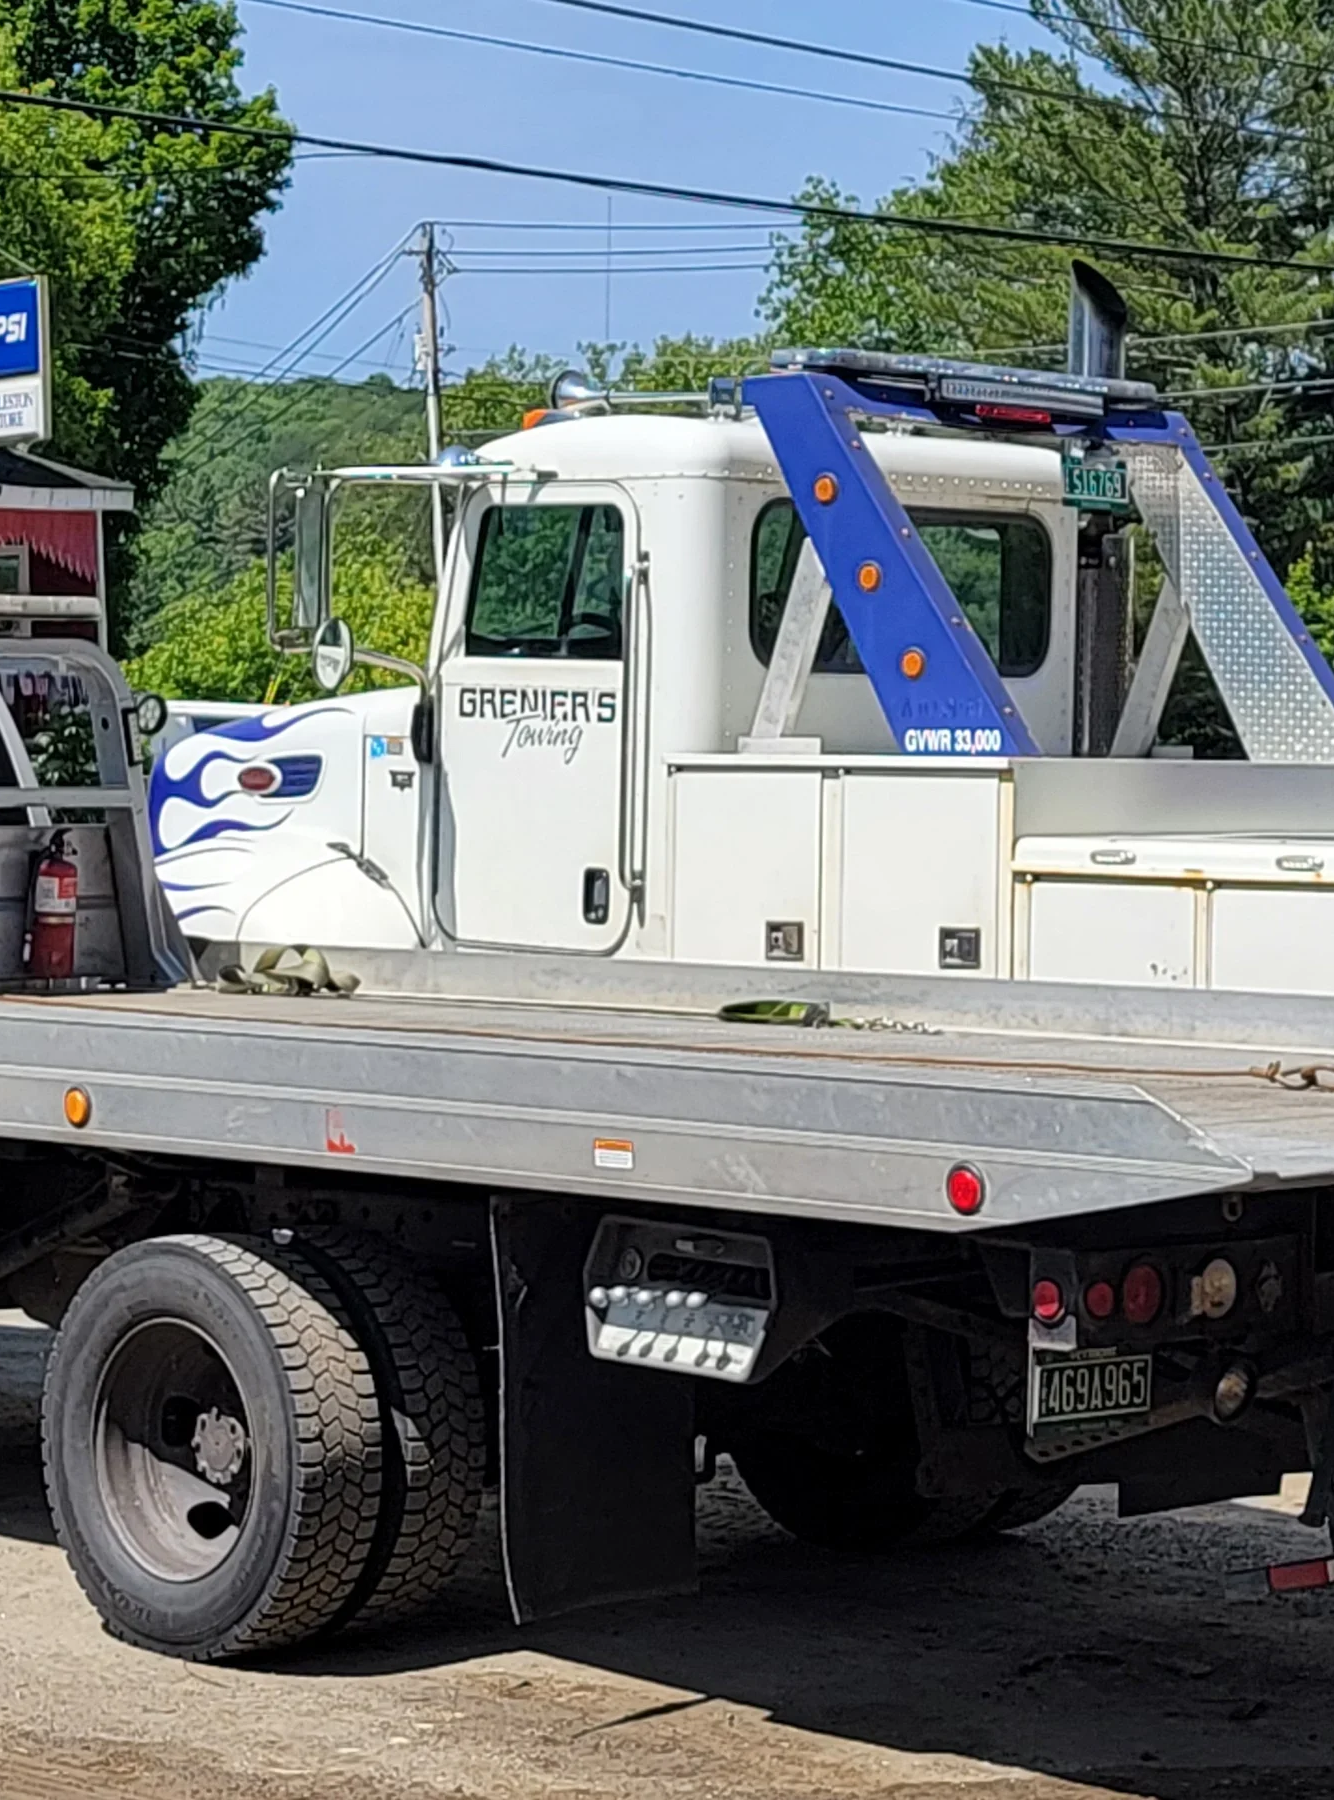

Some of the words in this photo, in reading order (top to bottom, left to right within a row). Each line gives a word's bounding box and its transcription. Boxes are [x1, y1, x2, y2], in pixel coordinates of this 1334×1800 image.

[459, 687, 616, 723] GRENIER'S
[501, 712, 583, 764] Towing
[905, 729, 952, 752] GVWR
[954, 729, 1001, 754] 33,000
[1048, 1360, 1146, 1415] 469A965
